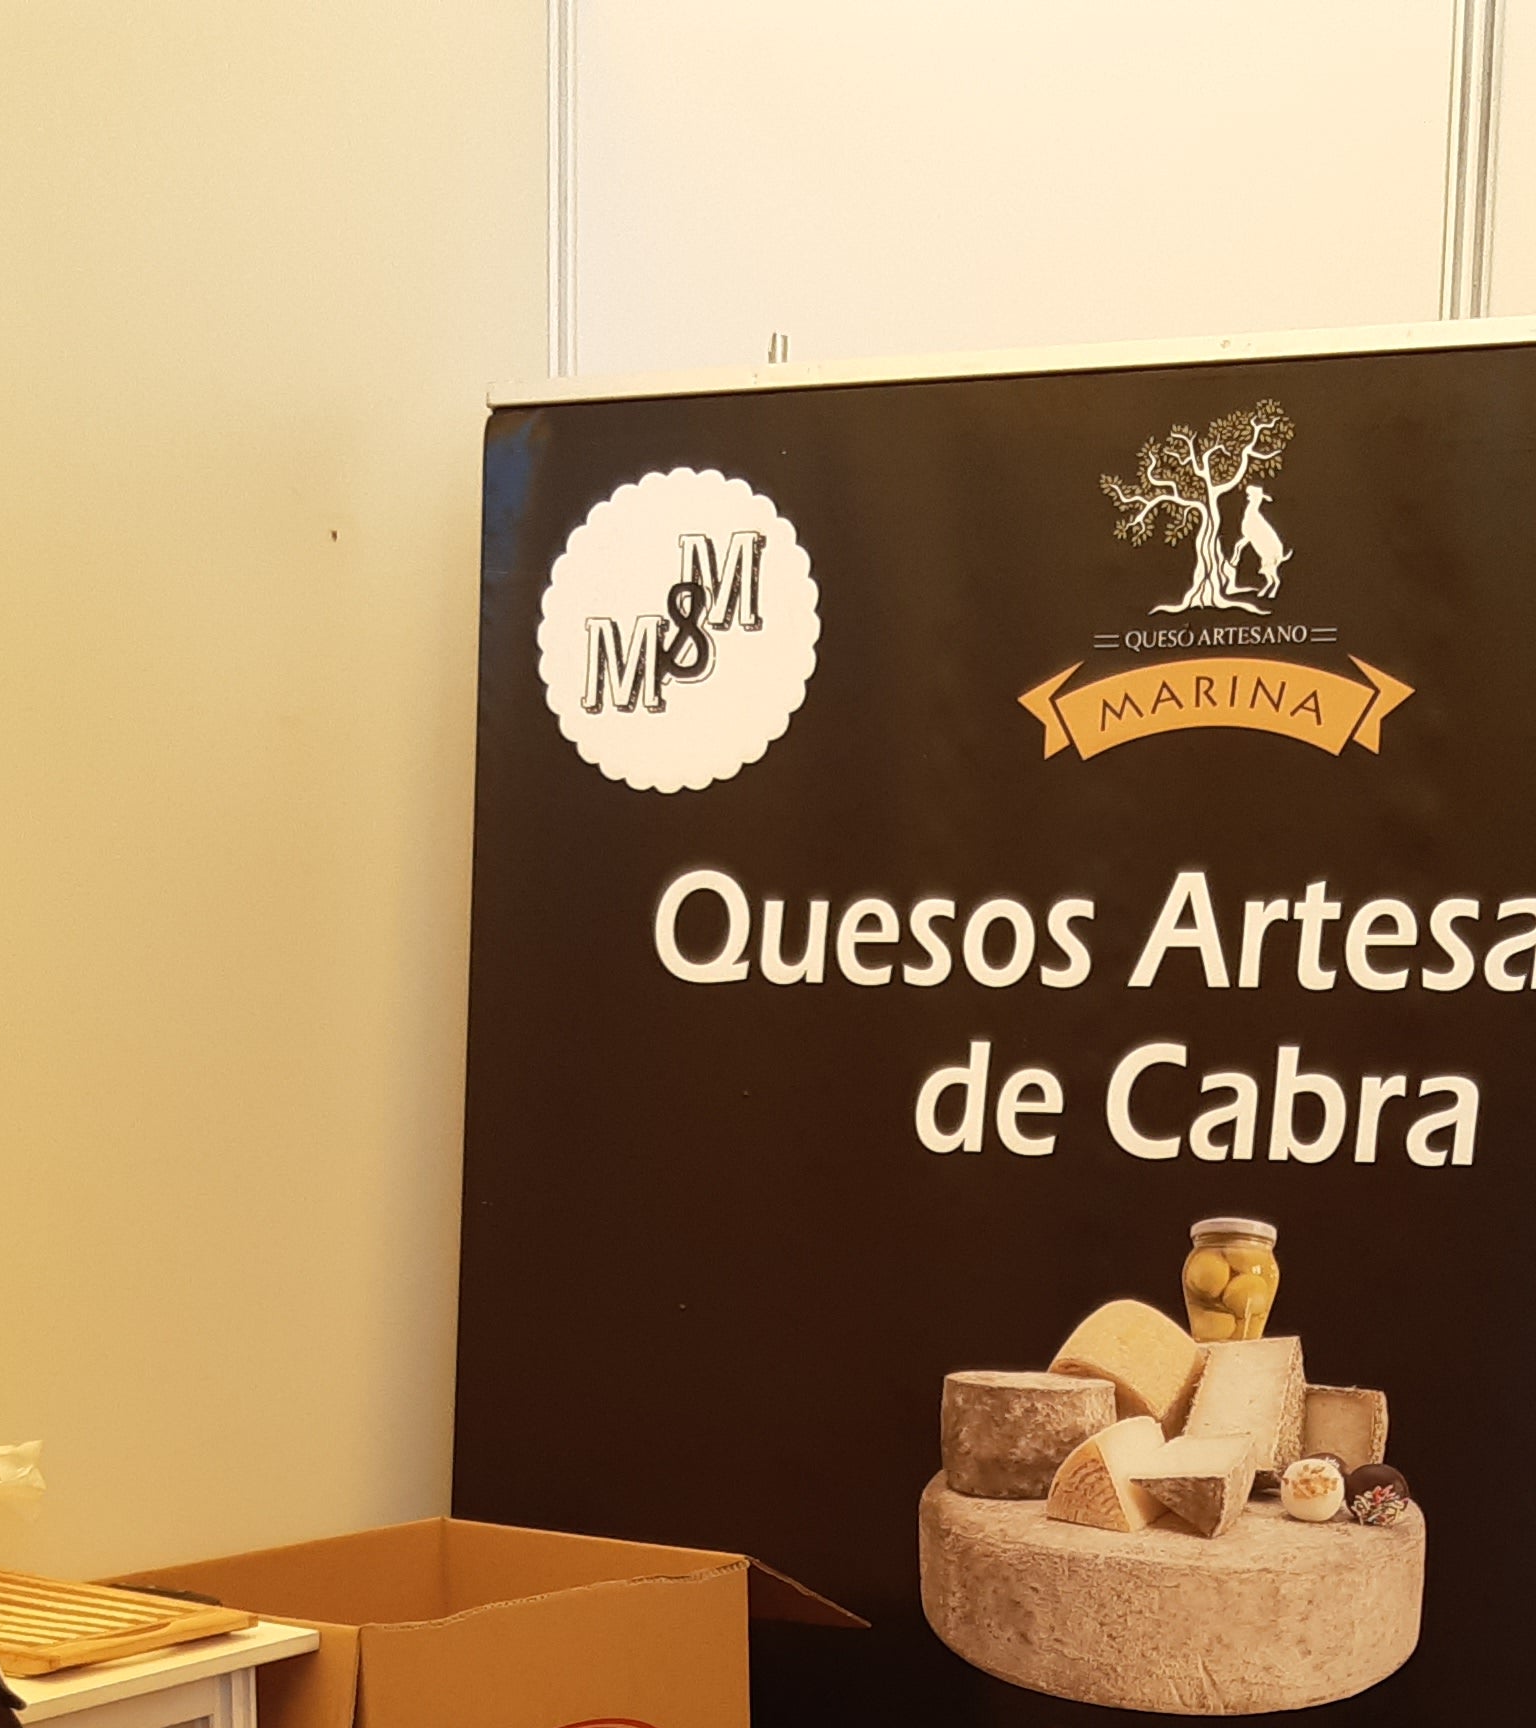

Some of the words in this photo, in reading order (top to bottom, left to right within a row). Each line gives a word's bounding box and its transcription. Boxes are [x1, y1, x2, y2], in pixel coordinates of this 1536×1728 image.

[1125, 629, 1194, 652] QUESO
[1198, 625, 1308, 646] ARTESANO
[1100, 675, 1322, 732] MARINA
[654, 868, 1095, 989] Quesos
[914, 1040, 1064, 1157] de
[1106, 1042, 1481, 1167] Cabra
